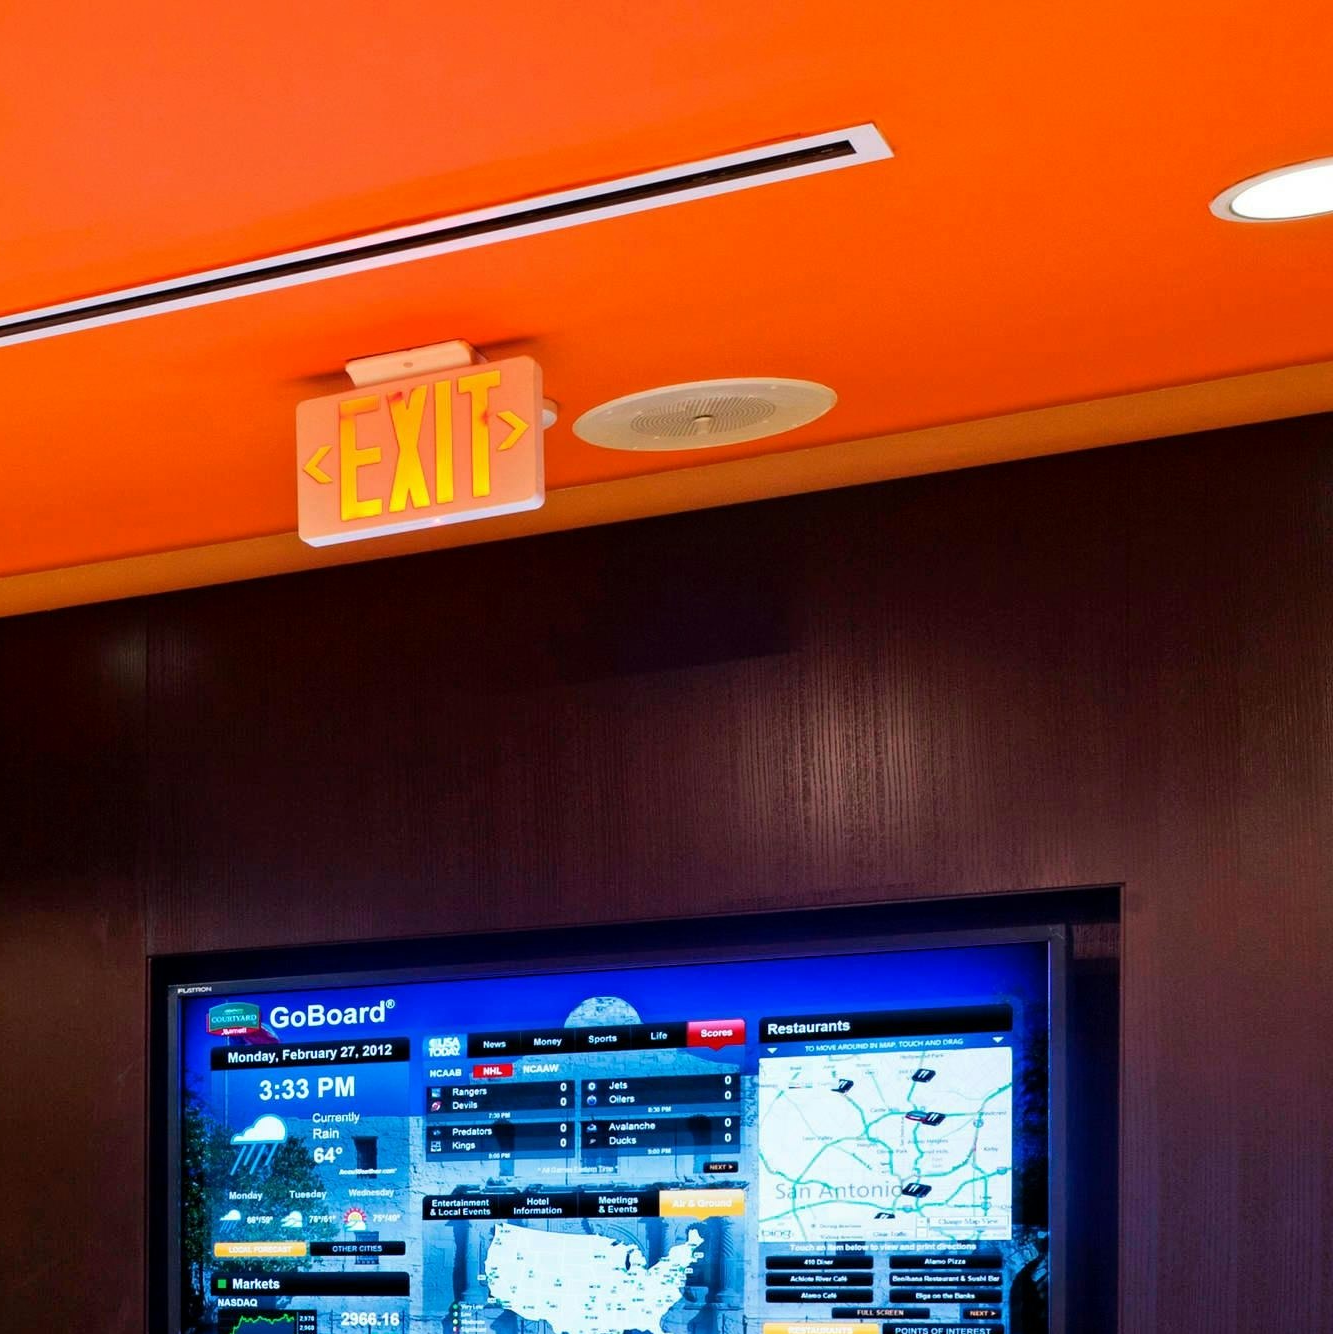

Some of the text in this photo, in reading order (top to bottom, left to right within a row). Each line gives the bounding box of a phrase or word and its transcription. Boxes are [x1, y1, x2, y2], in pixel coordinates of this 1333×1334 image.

[340, 370, 501, 521] EXIT
[211, 1014, 257, 1024] COURTYARD
[767, 1020, 850, 1035] Restaurants
[651, 1031, 668, 1040] Life
[700, 1028, 733, 1038] Scores
[534, 1038, 562, 1046] Money
[588, 1035, 617, 1044] Sports
[898, 1040, 923, 1048] TOUCH
[483, 1041, 506, 1049] News
[227, 1044, 392, 1064] Monday, February 27, 2012
[430, 1068, 462, 1077] NCAAB
[483, 1067, 502, 1075] NHL
[523, 1064, 560, 1073] NCAAW
[724, 1076, 731, 1085] 0
[259, 1075, 355, 1100] 3:33 PM
[560, 1083, 567, 1092] 0
[609, 1082, 628, 1090] Jets
[452, 1087, 487, 1097] Rangers
[724, 1091, 731, 1100] 0
[560, 1098, 567, 1106] 0
[609, 1094, 635, 1103] Oilers
[452, 1101, 478, 1110] Devils
[312, 1112, 360, 1124] Currently
[724, 1118, 731, 1127] 0
[560, 1123, 567, 1132] 0
[609, 1122, 656, 1131] Avalanche
[313, 1128, 339, 1139] Rain
[452, 1127, 492, 1136] Predators
[609, 1136, 637, 1145] Ducks
[724, 1133, 731, 1142] 0
[452, 1141, 476, 1151] Kings
[560, 1138, 567, 1147] 0
[313, 1146, 343, 1163] 64°
[289, 1190, 327, 1200] Tuesday
[348, 1188, 394, 1198] Wednesday
[775, 1182, 903, 1199] San Antonio
[229, 1191, 263, 1201] Monday
[598, 1196, 638, 1205] Meetings
[439, 1208, 461, 1216] Local
[513, 1207, 562, 1215] Information
[790, 1244, 815, 1252] Touch
[845, 1243, 868, 1251] below
[869, 1243, 878, 1251] to
[879, 1243, 899, 1251] view
[900, 1243, 915, 1251] and
[917, 1243, 935, 1252] print
[937, 1243, 977, 1251] directions
[233, 1278, 280, 1289] Markets
[217, 1298, 258, 1307] NASDAQ
[340, 1312, 400, 1327] 2966.16
[895, 1327, 928, 1334] POINTS
[931, 1327, 942, 1334] OF
